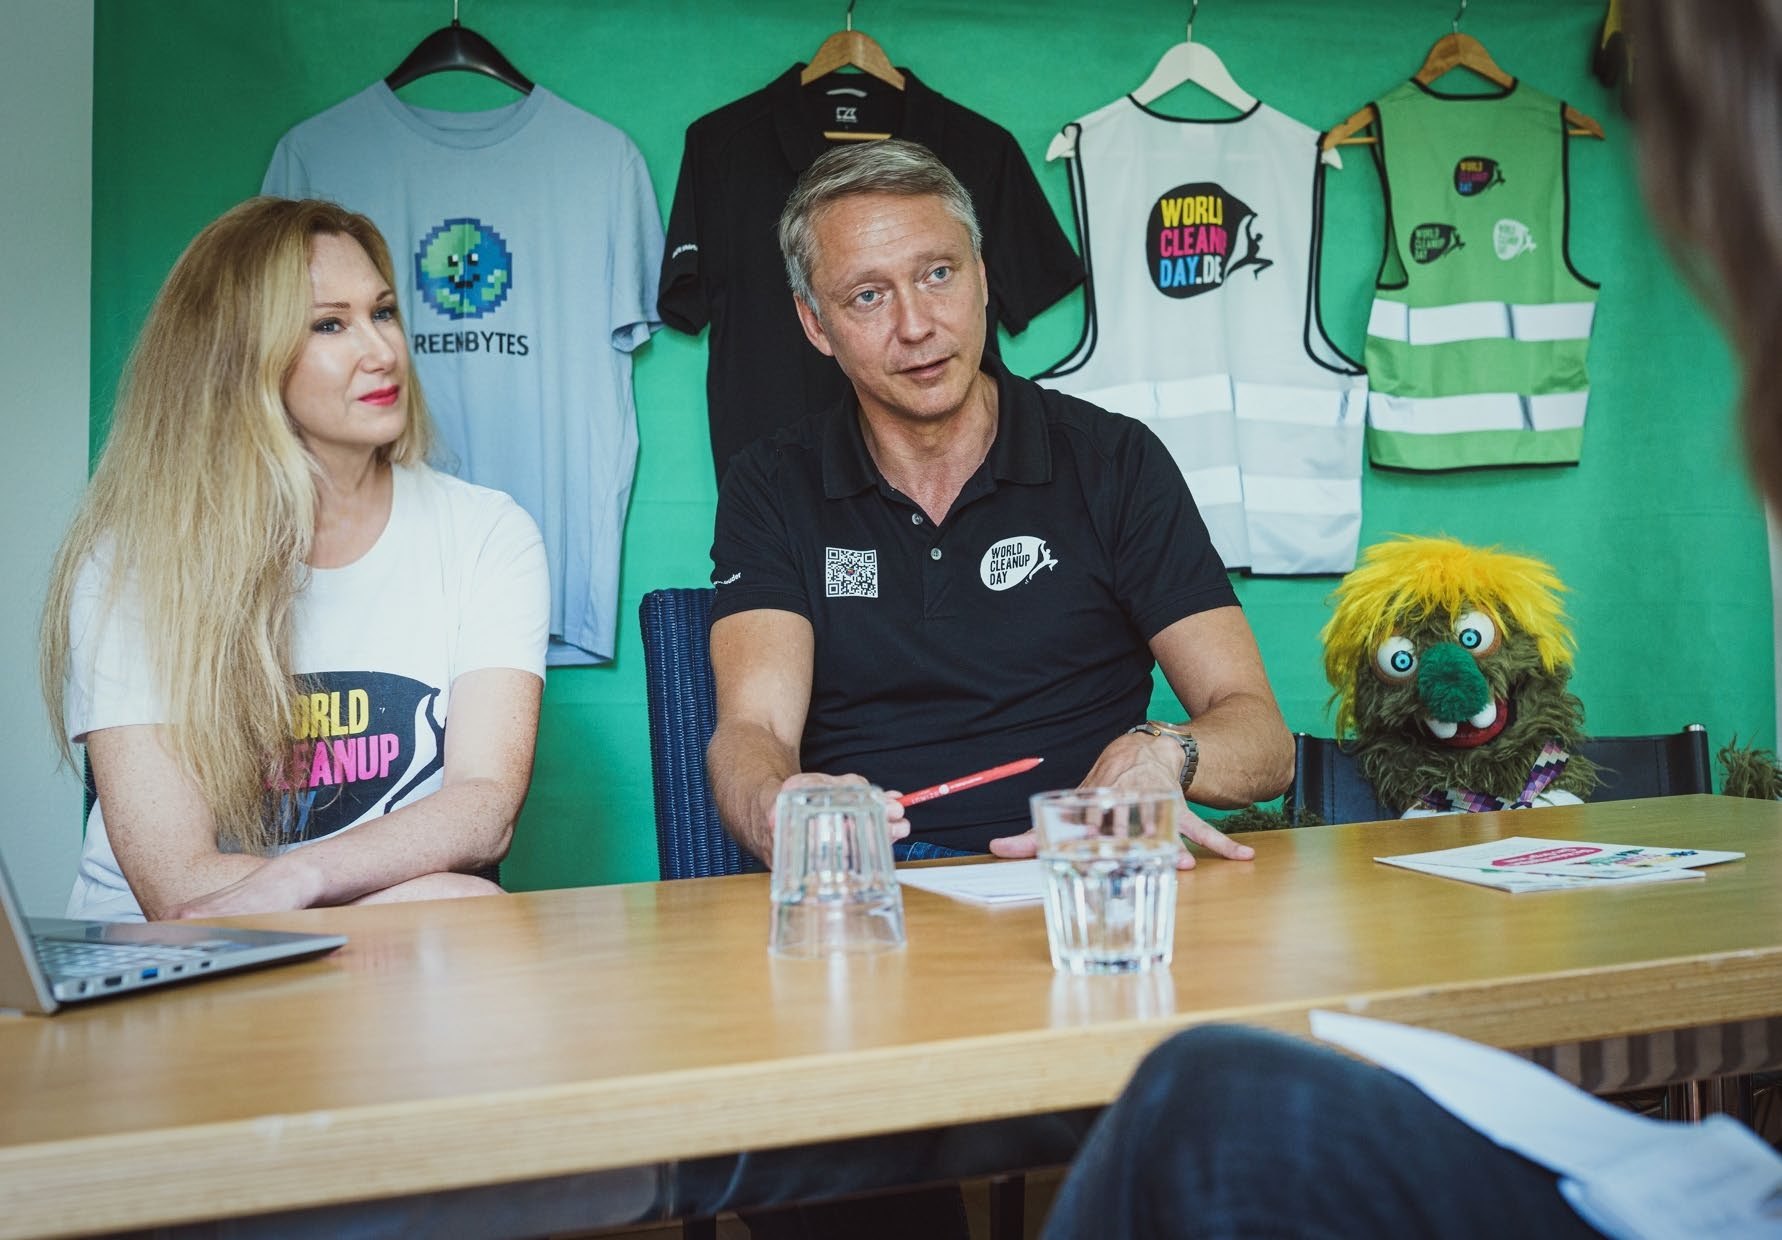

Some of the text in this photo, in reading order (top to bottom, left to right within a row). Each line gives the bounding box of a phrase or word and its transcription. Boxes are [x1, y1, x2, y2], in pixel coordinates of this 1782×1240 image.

[1160, 255, 1222, 288] DAY.DE
[411, 331, 529, 356] REENBYTES
[991, 542, 1023, 560] WORLD
[990, 554, 1030, 572] CLEANUP
[989, 571, 1008, 586] DAY
[291, 688, 369, 740] ORLD
